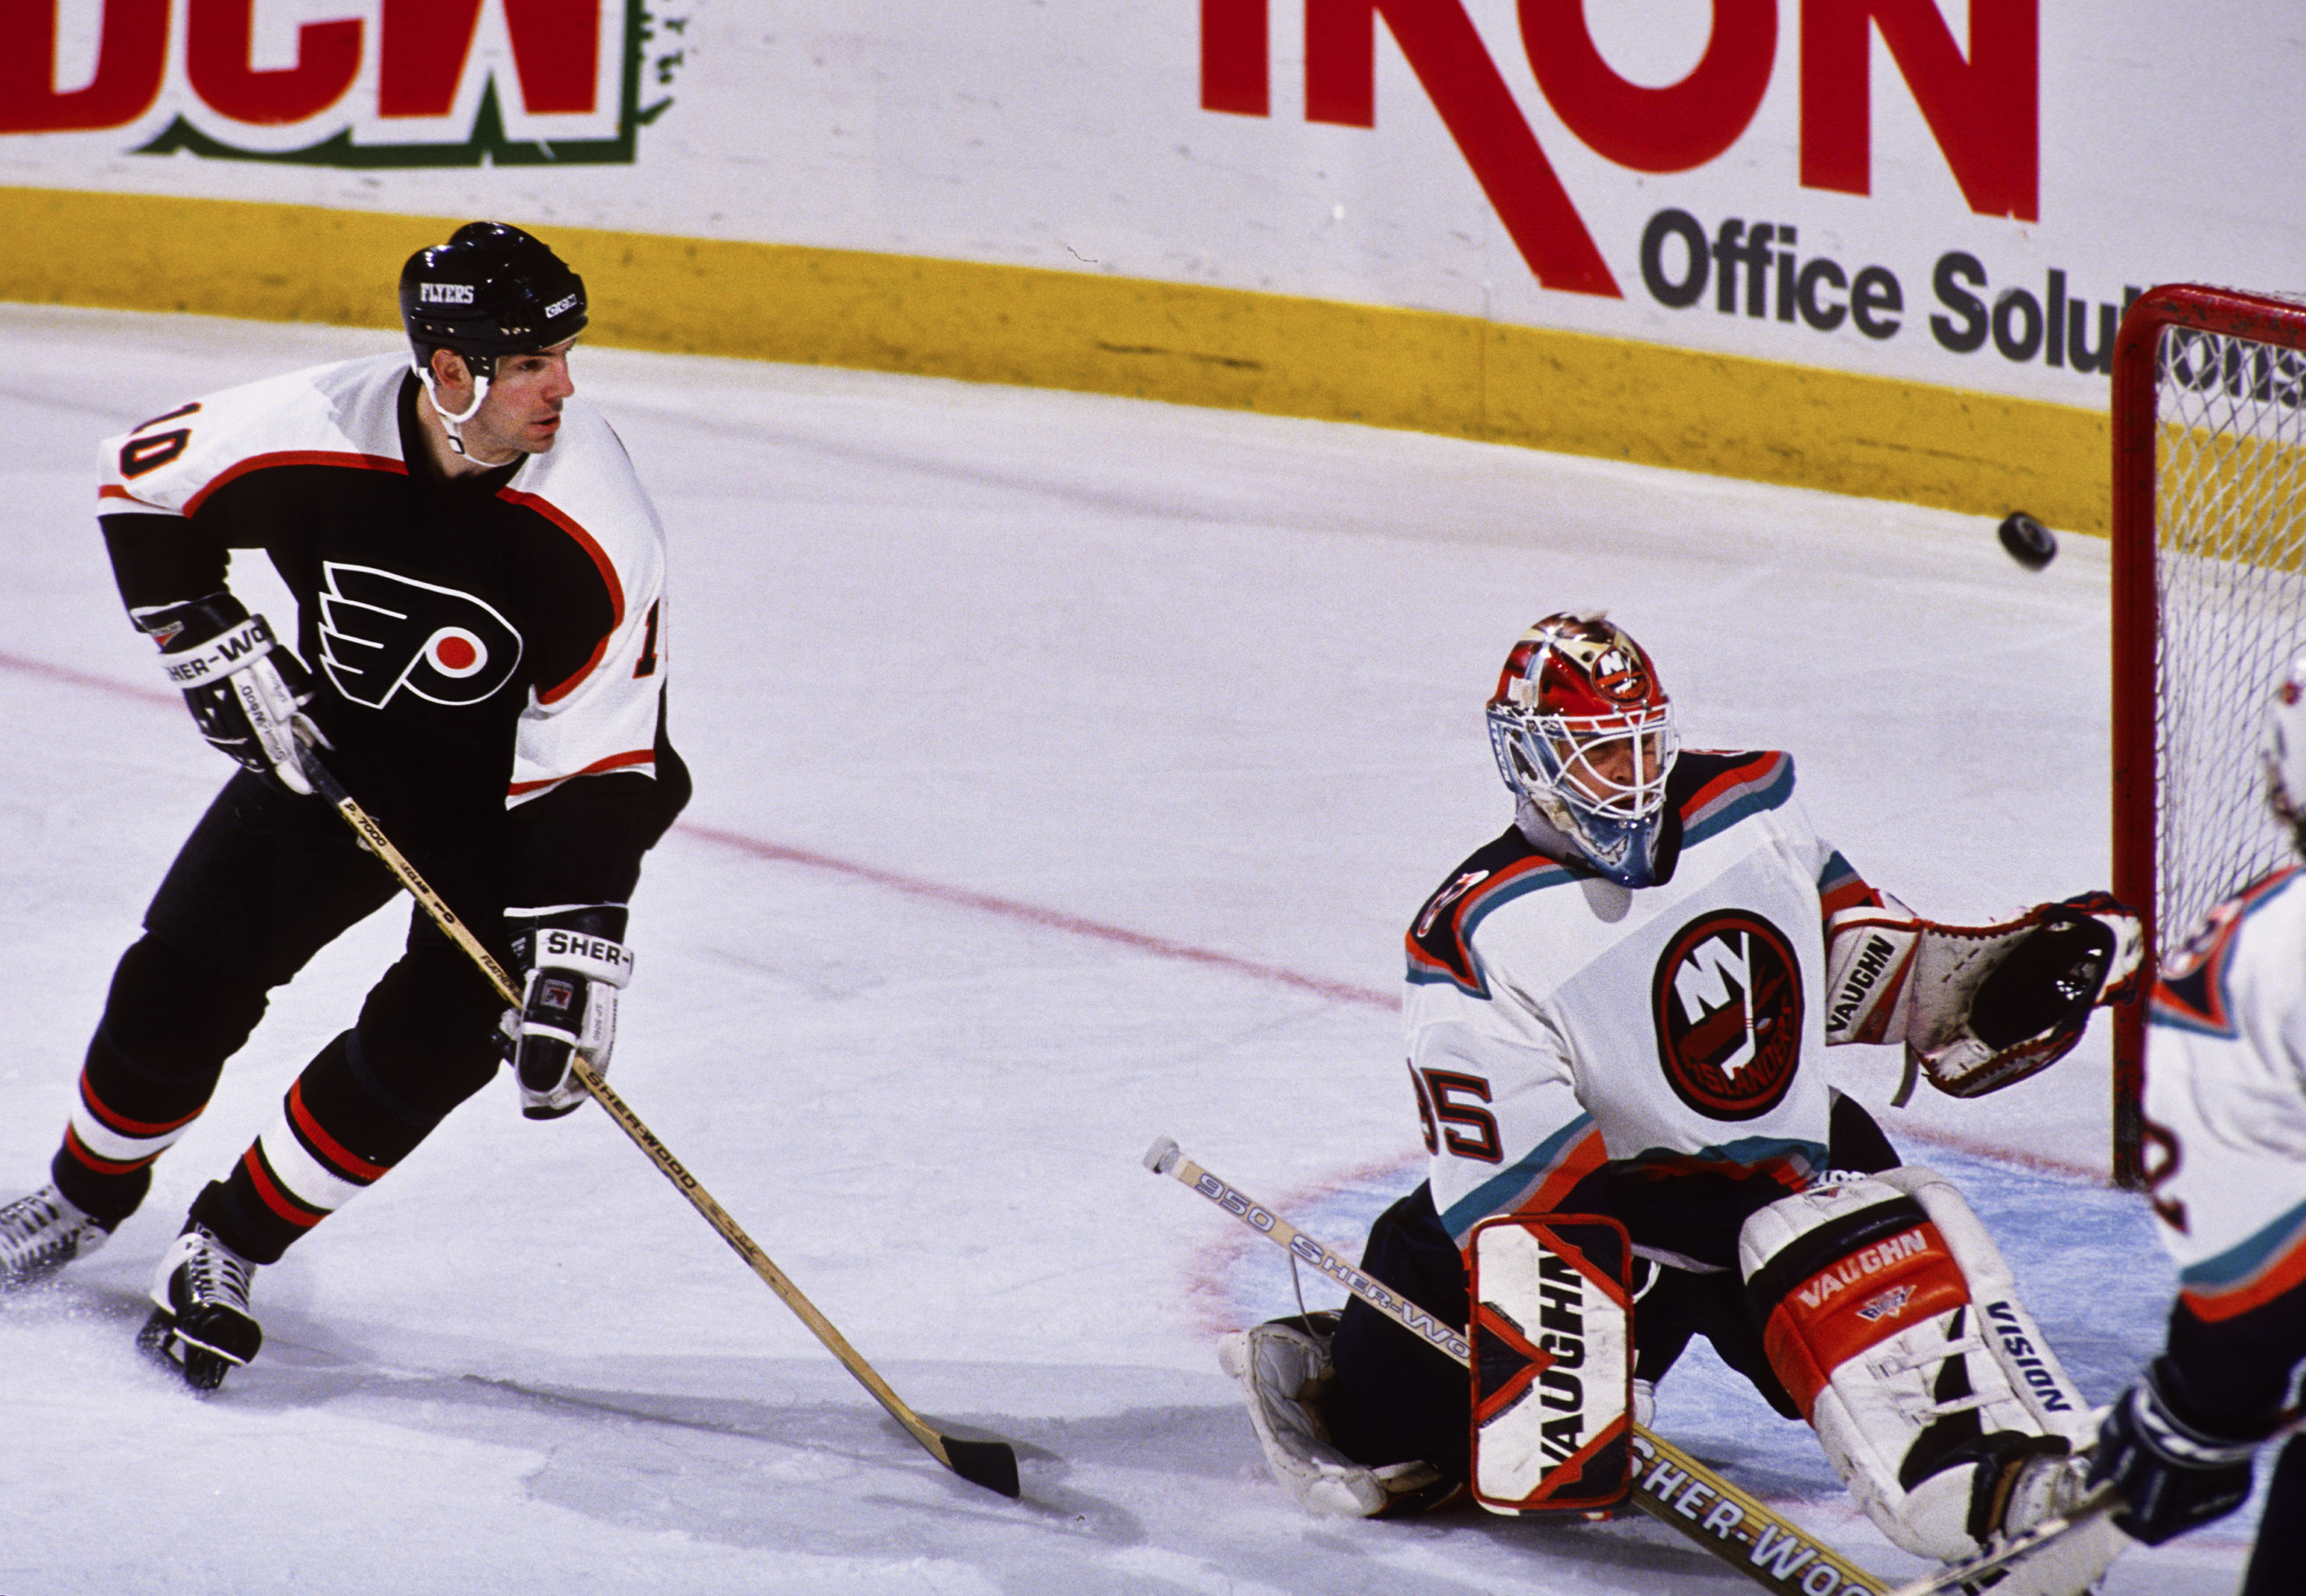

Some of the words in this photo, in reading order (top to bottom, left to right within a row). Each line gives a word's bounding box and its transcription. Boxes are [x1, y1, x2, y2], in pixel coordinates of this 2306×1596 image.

[420, 282, 474, 304] FLYERS
[1639, 208, 1904, 340] Office
[358, 817, 387, 848] 7000
[434, 901, 456, 924] 10
[1674, 931, 1757, 1082] NY
[1826, 935, 1895, 1032] VAUGHN
[586, 1071, 697, 1190] SHER-WOOD
[1196, 1173, 1275, 1233] 950
[1798, 1230, 1928, 1308] VAUGHN
[1985, 1301, 2073, 1413] VISION
